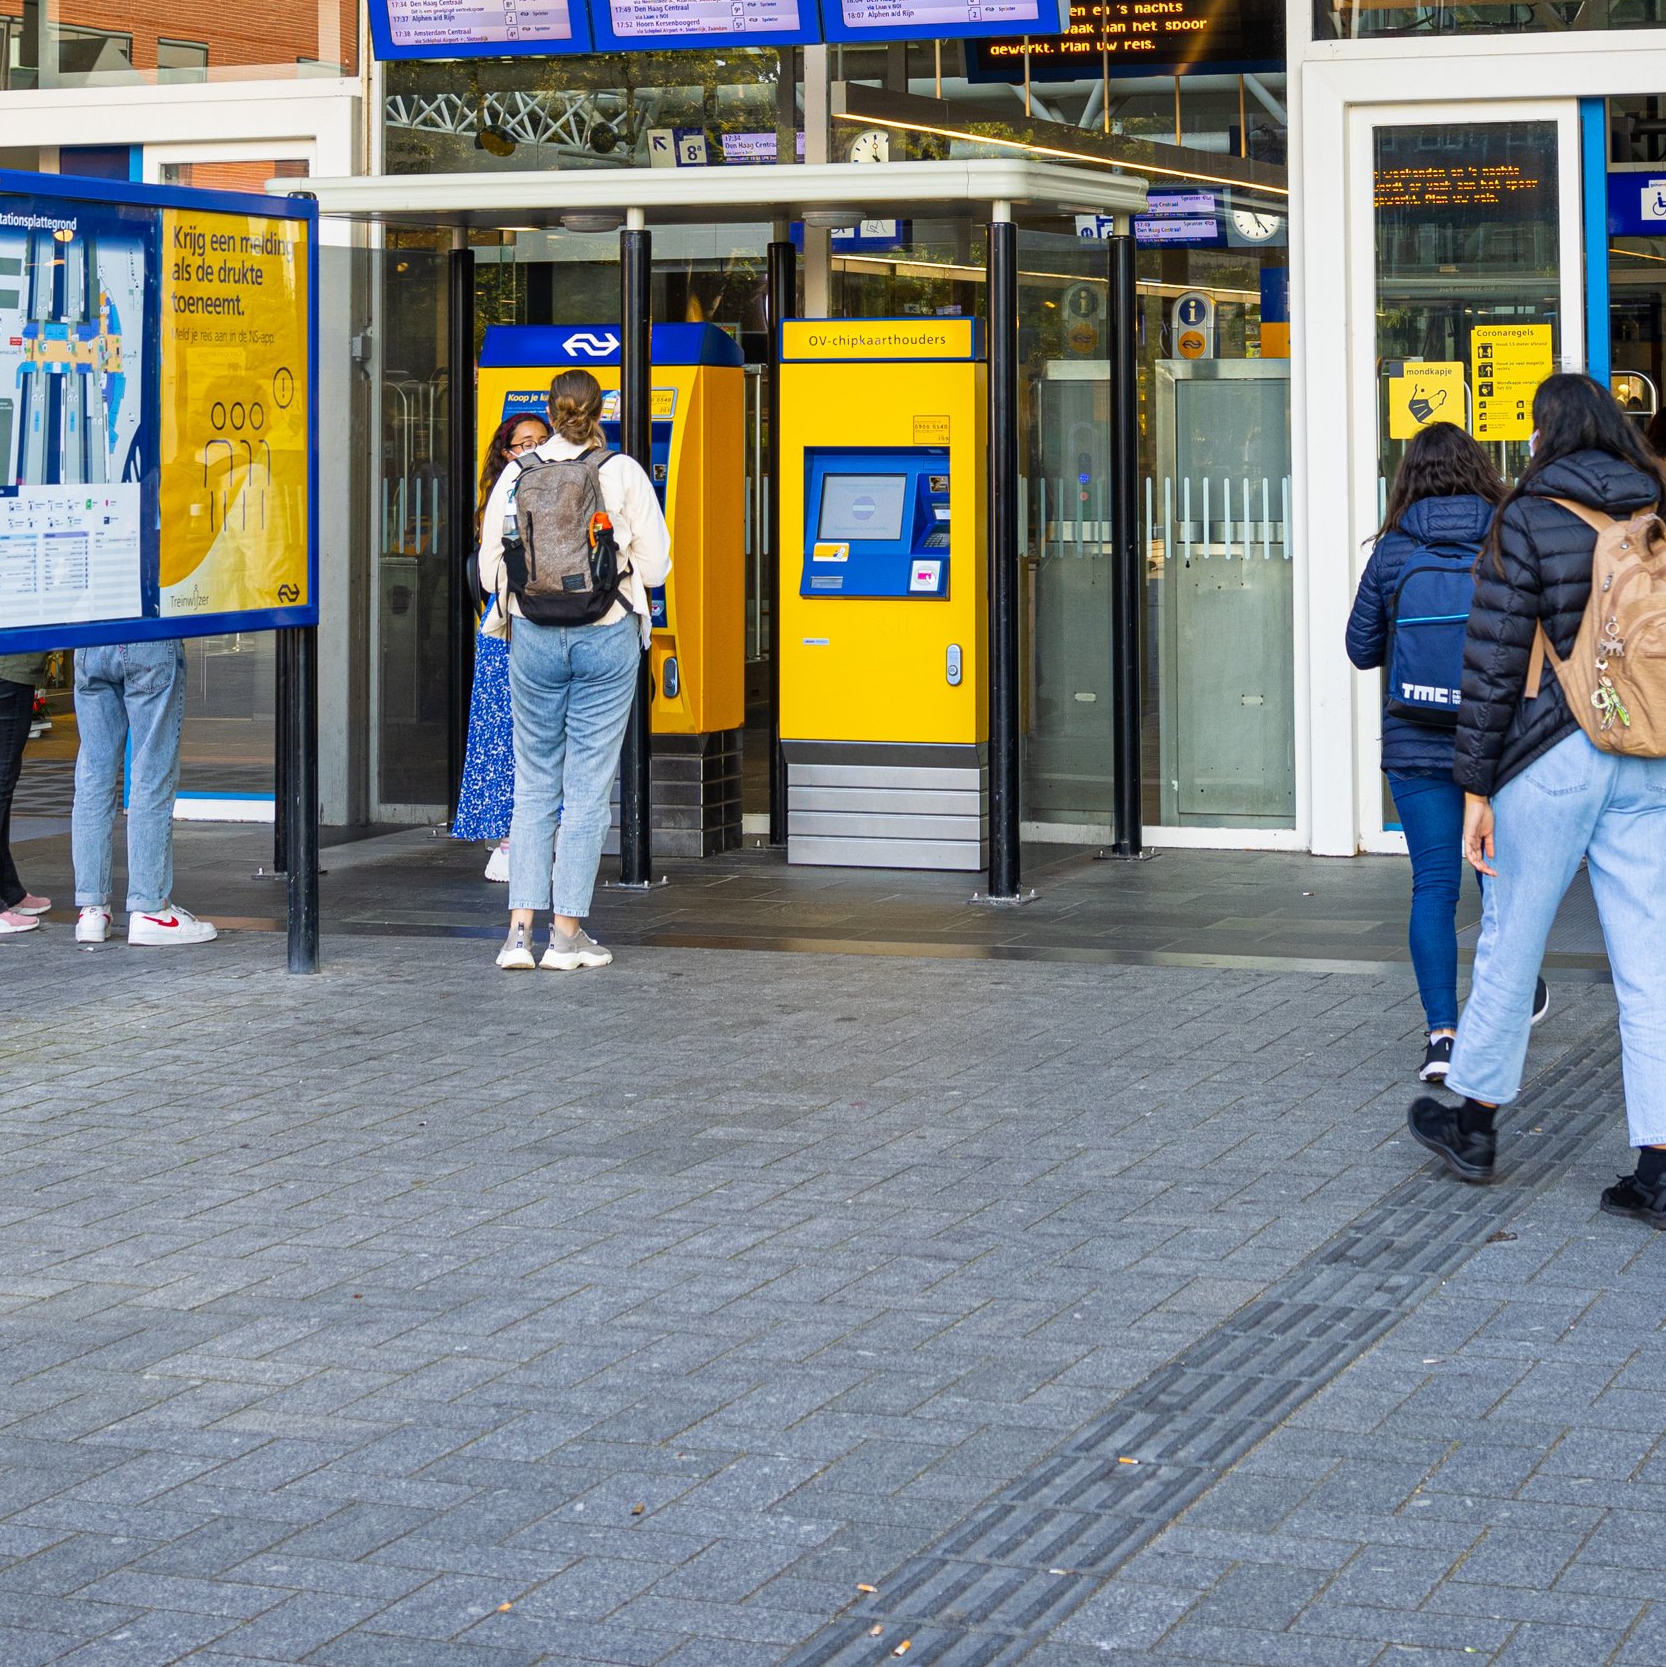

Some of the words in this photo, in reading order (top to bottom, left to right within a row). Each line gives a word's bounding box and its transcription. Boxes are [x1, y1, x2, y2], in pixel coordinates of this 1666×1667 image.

[422, 0, 437, 8] Haag
[647, 5, 663, 13] Haag
[1134, 3, 1183, 14] nachts
[444, 14, 455, 22] Rijn
[868, 11, 890, 19] Alphen
[656, 19, 700, 27] Kersenboogerd
[687, 145, 702, 161] 8a
[173, 226, 206, 257] Krijg
[210, 234, 236, 252] een
[241, 231, 294, 262] melding
[172, 257, 191, 281] als
[196, 258, 214, 282] de
[218, 259, 263, 285] drukte
[171, 292, 245, 316] toeneemt.
[172, 327, 189, 341] Meld
[191, 329, 197, 344] je
[201, 329, 212, 341] reis
[215, 332, 228, 342] aan
[239, 330, 247, 342] de
[1477, 329, 1534, 338] Coronaregels
[808, 334, 946, 347] OV-chipkaarthouders
[1406, 368, 1452, 376] mondkapje
[507, 393, 528, 402] Koop
[530, 394, 539, 403] je
[170, 584, 209, 610] Treinwijzer
[1402, 683, 1449, 704] TMC
